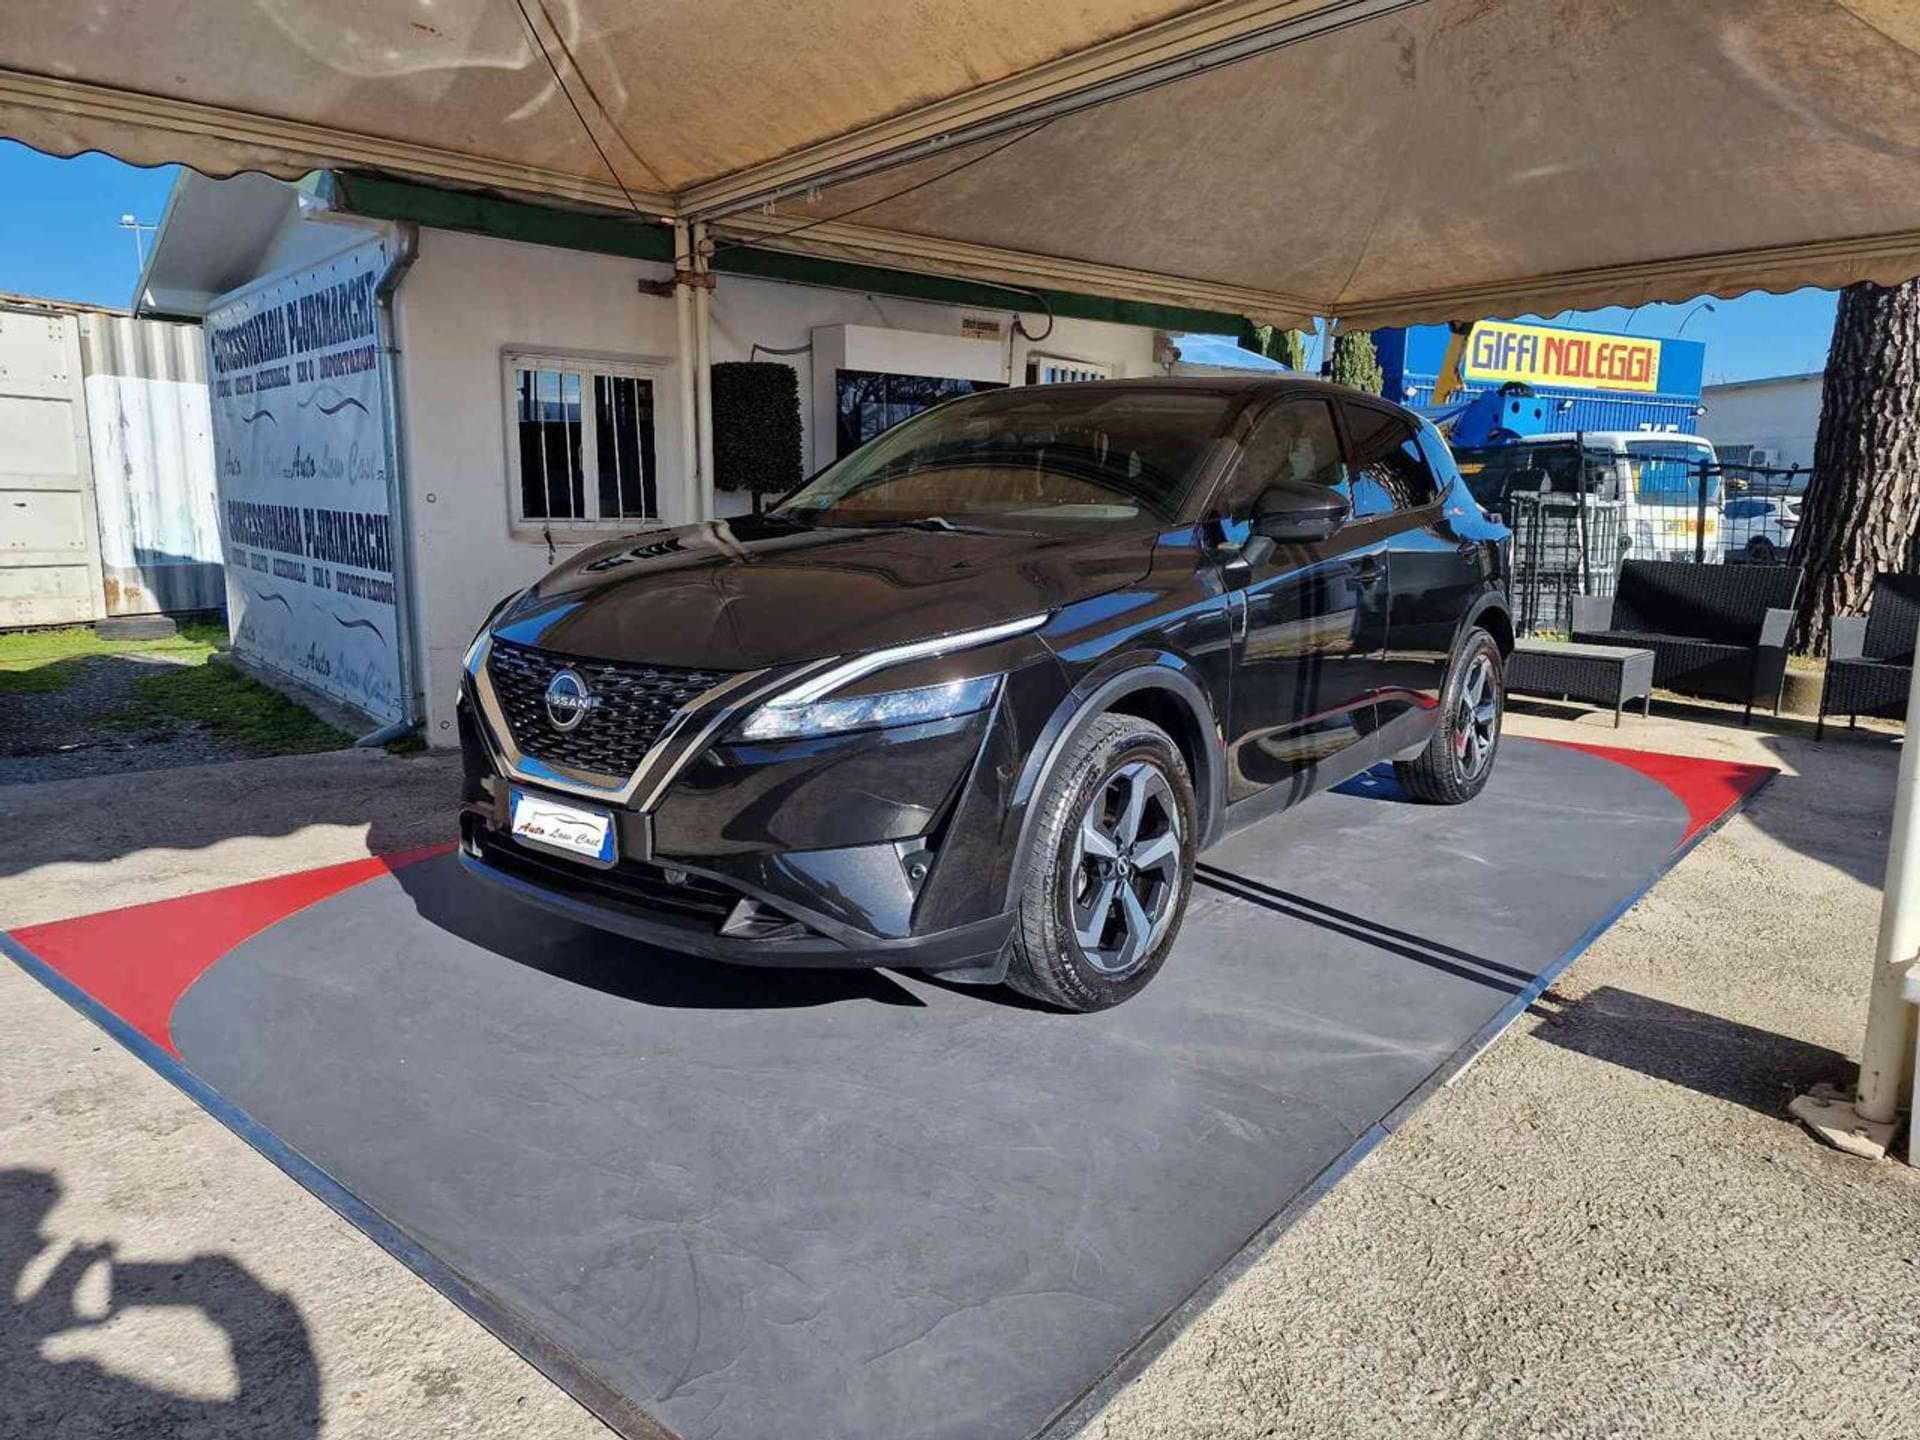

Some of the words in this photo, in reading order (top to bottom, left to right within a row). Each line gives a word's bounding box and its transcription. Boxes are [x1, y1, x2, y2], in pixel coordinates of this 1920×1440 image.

[1471, 329, 1539, 373] GIFFI
[1542, 336, 1653, 383] NOLEGGI
[303, 507, 392, 573] PLURIMARCHI
[518, 822, 545, 835] Auto
[548, 828, 573, 841] Low
[574, 833, 601, 847] Cost
